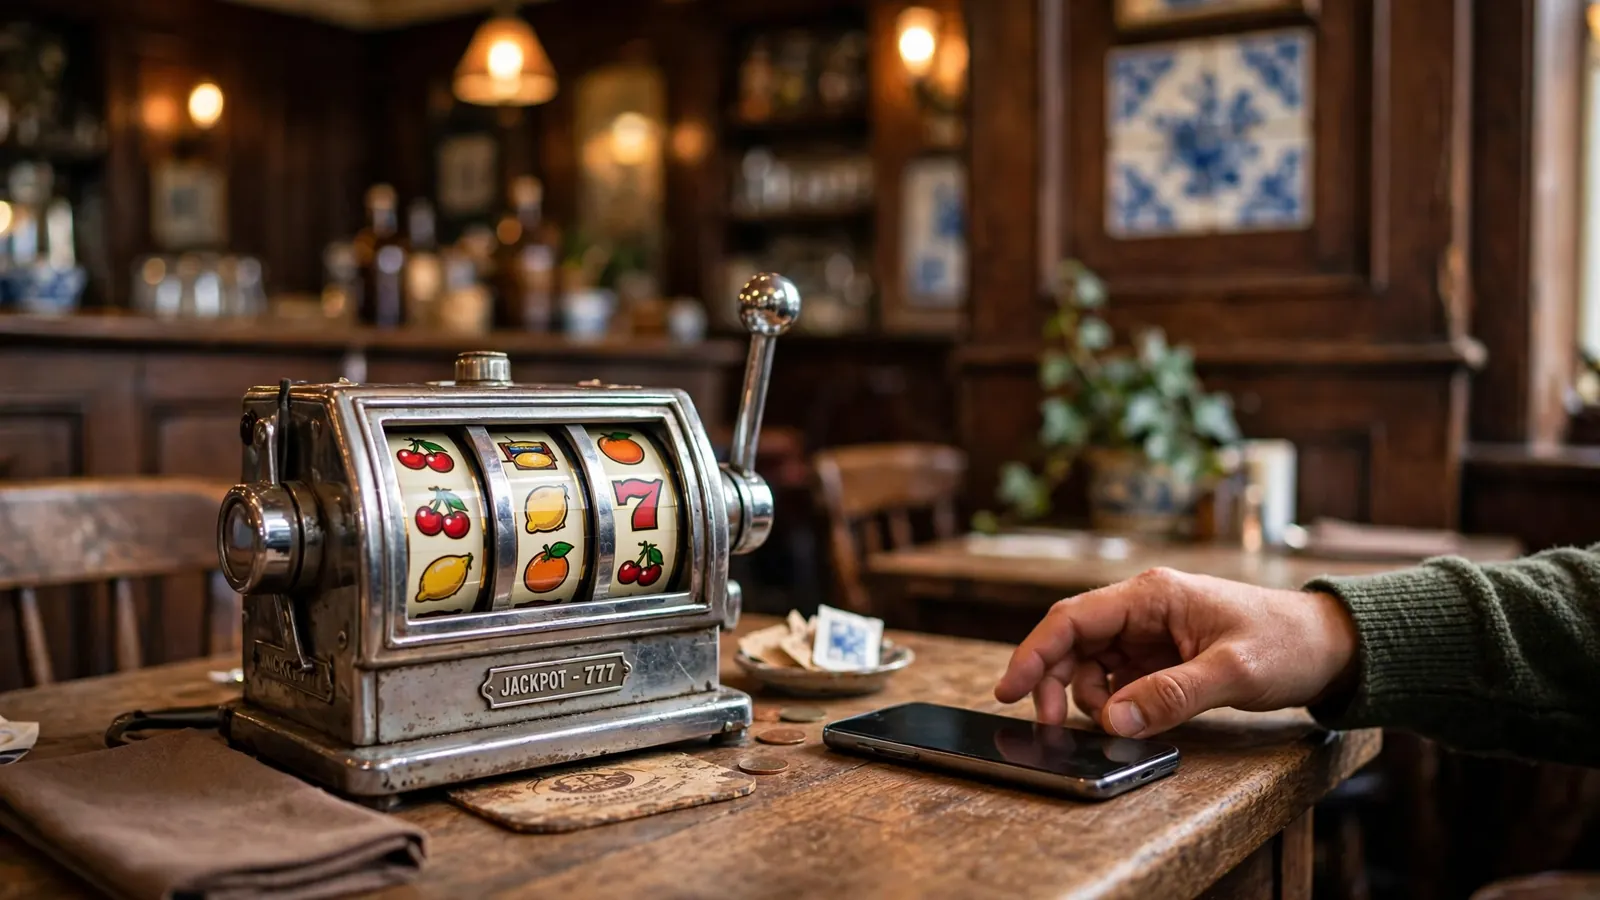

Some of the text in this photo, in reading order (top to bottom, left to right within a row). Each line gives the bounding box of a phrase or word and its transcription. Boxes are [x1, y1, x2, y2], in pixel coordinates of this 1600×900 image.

[612, 478, 663, 531] 7
[501, 669, 567, 697] JACKPOT
[584, 663, 616, 685] 777
